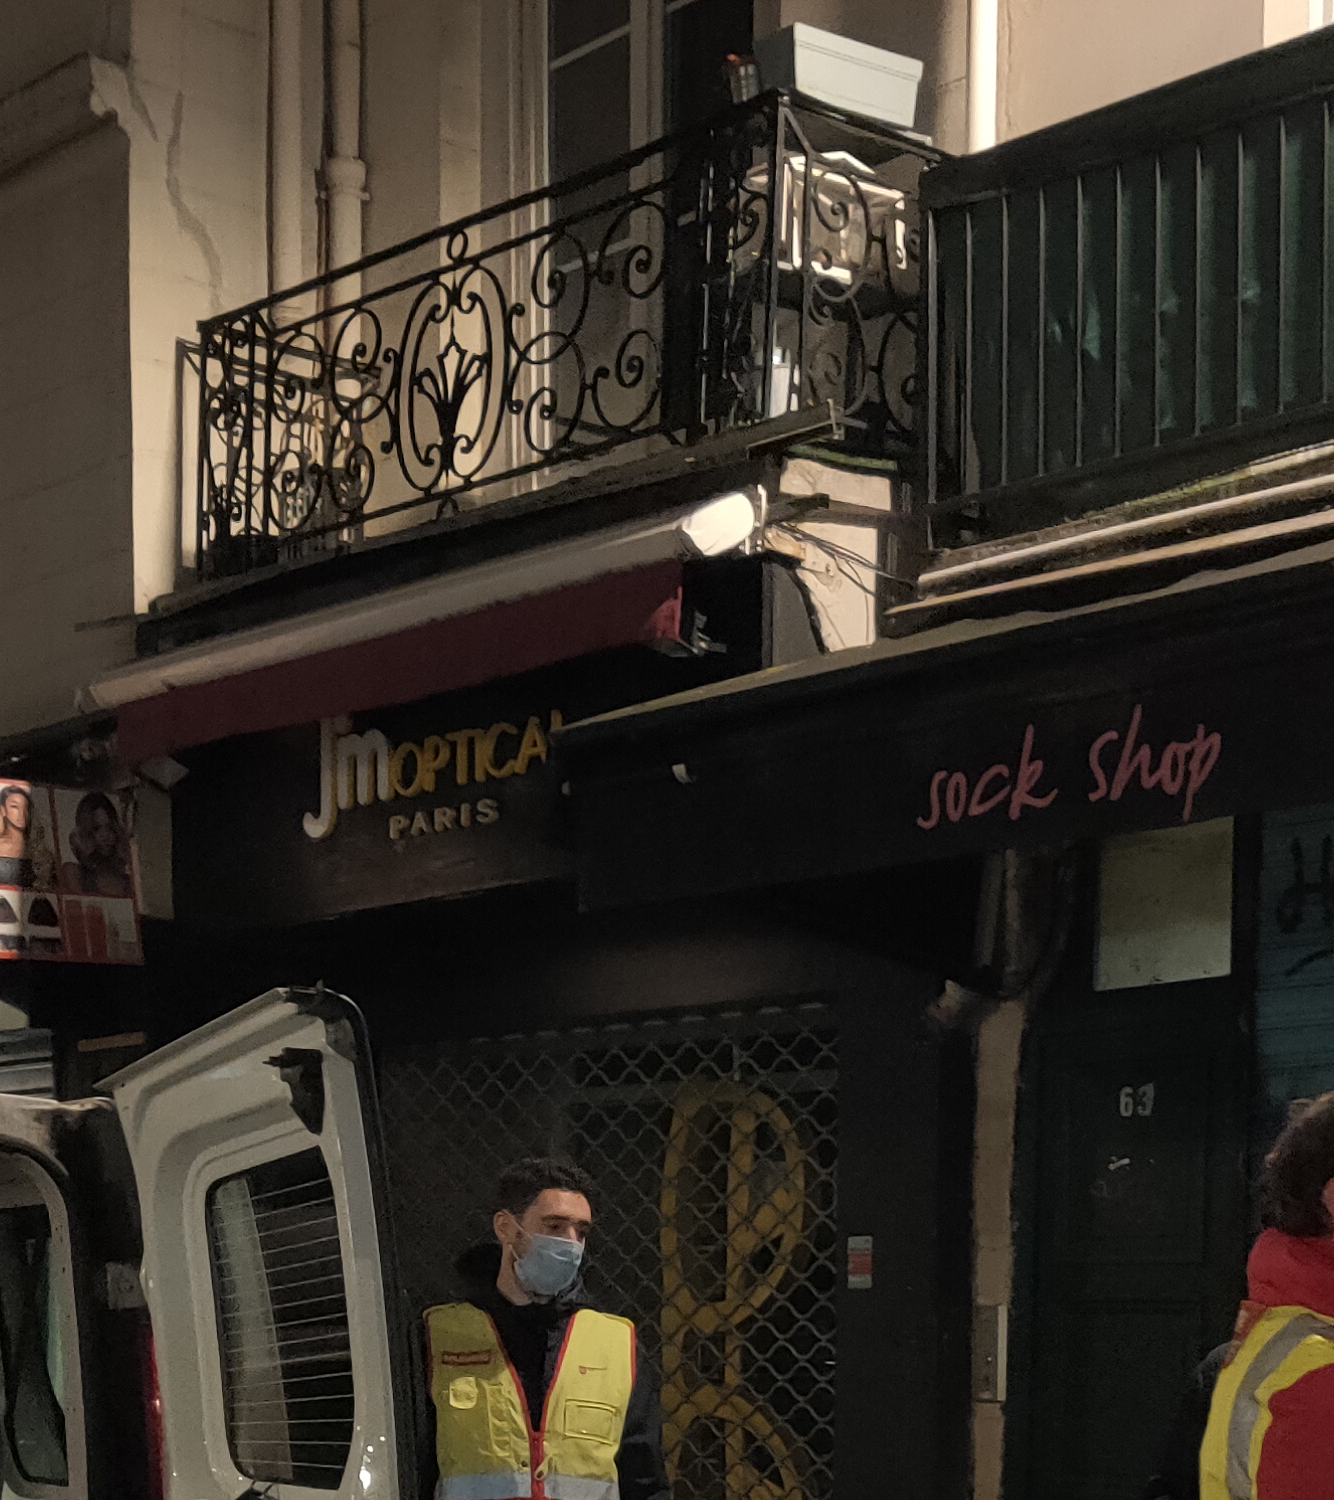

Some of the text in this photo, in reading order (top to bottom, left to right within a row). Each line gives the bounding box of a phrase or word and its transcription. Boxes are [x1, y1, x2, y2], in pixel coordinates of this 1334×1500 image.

[916, 703, 1223, 830] sock shop
[388, 798, 500, 840] PARIS
[1119, 1083, 1155, 1117] 63
